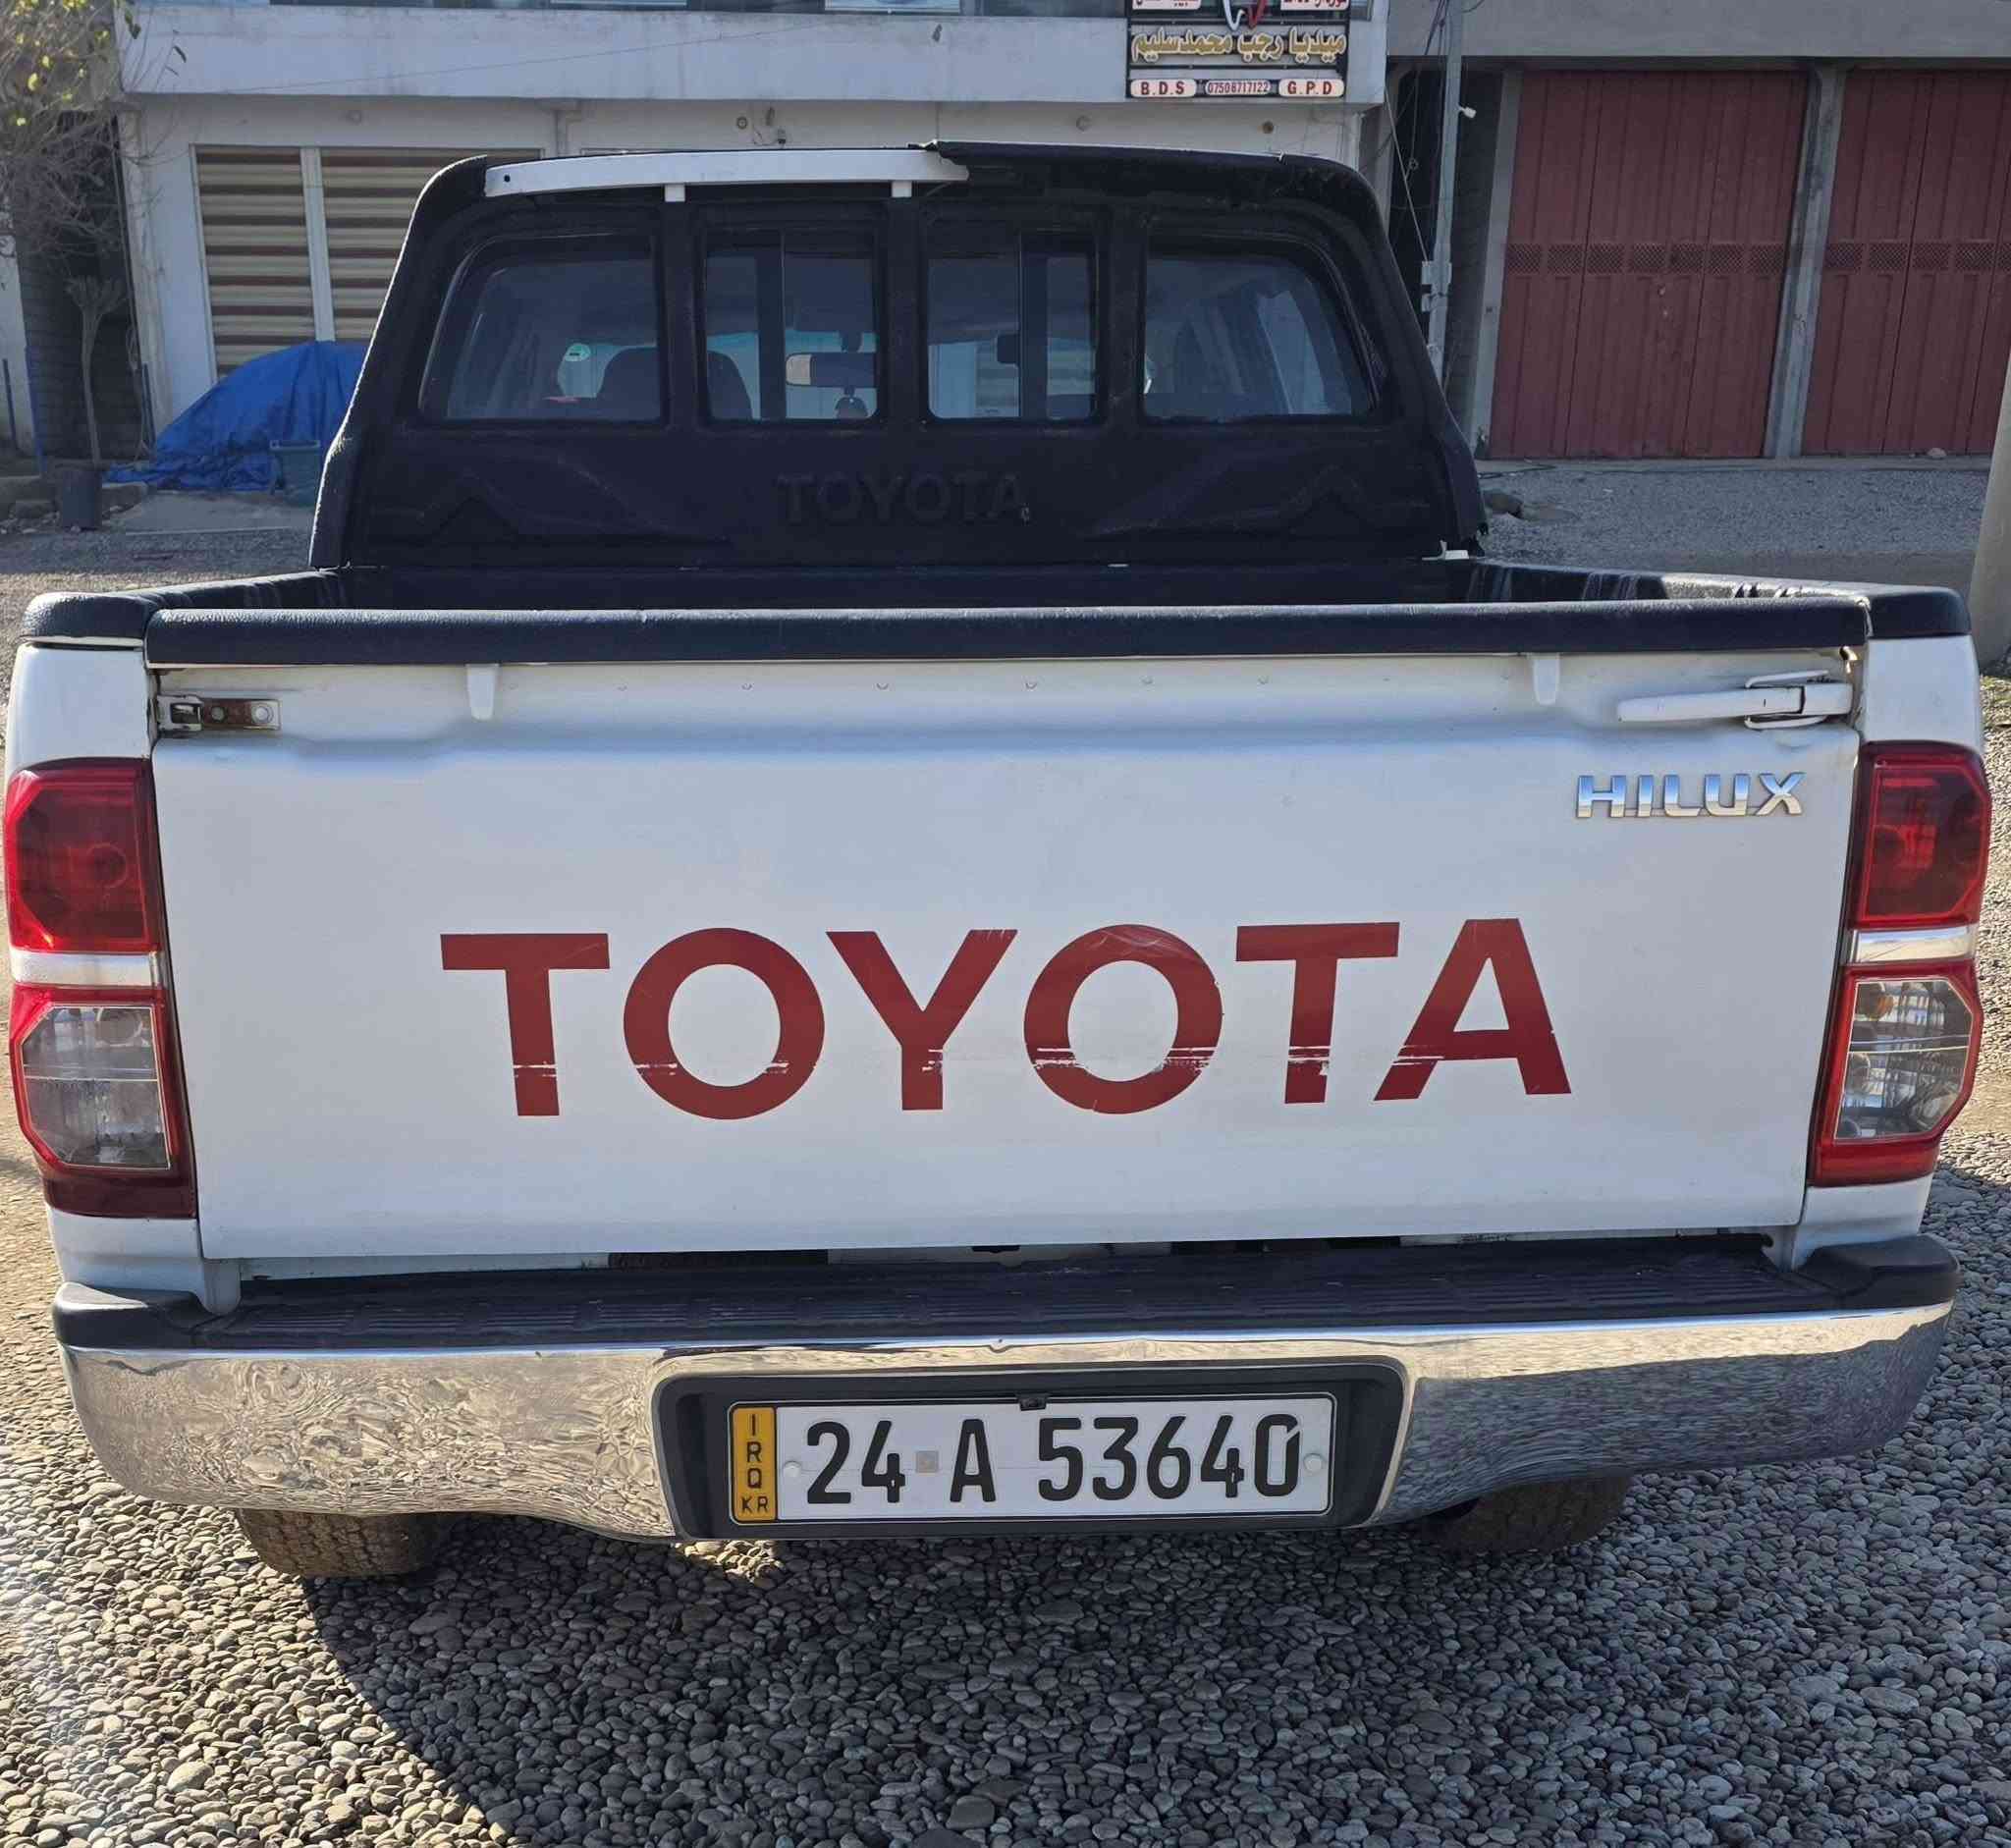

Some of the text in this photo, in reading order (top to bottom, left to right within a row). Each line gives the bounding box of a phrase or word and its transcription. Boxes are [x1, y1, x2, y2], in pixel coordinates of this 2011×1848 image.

[774, 471, 1030, 524] TOYOTA
[1577, 772, 1806, 818] HILUX
[440, 918, 1571, 1119] TOYOTA
[806, 1414, 1300, 1504] 24 A 53640
[741, 1495, 768, 1513] KR
